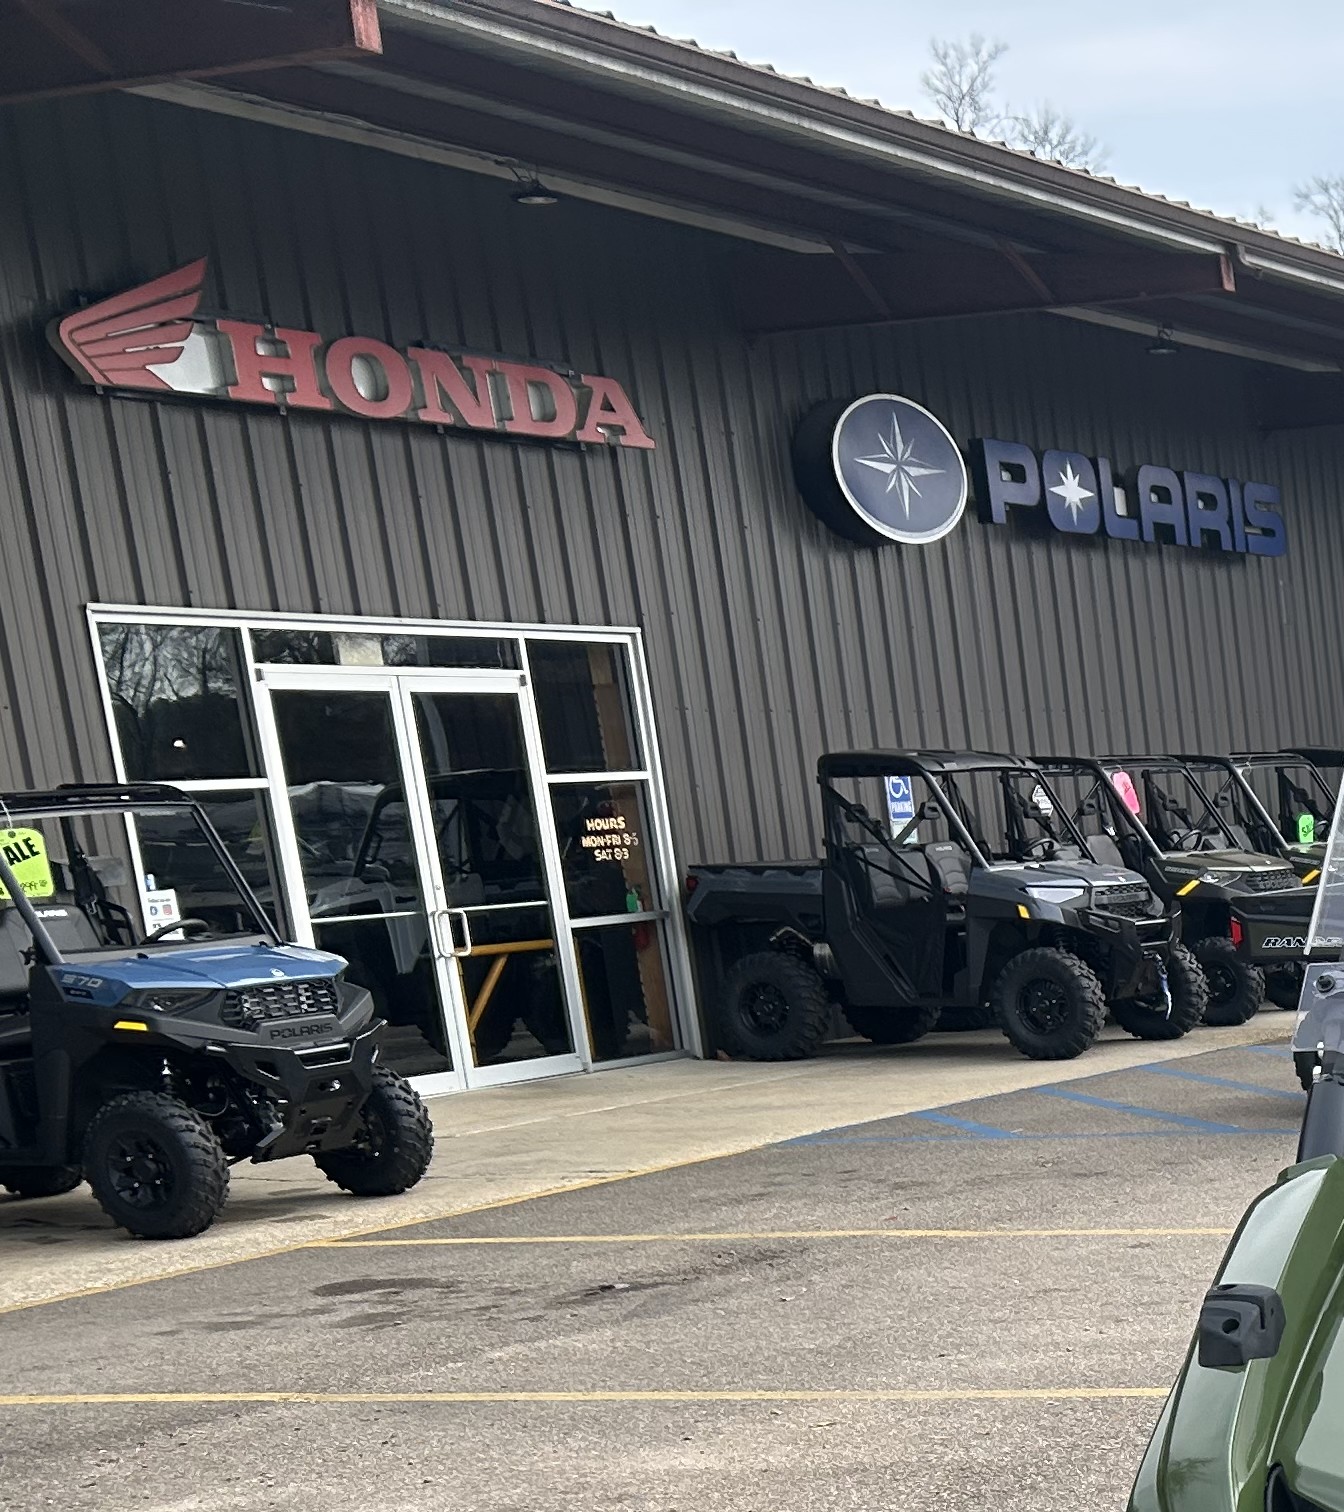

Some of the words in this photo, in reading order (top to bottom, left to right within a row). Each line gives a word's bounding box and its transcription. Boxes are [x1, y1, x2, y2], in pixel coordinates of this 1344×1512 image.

[217, 319, 655, 449] HONDA
[973, 437, 1288, 557] POLARIS
[585, 816, 626, 832] HOURS
[581, 834, 621, 848] MON-FRI
[2, 837, 41, 867] ALE
[594, 848, 613, 862] SAT
[269, 1022, 333, 1041] POLARIS
